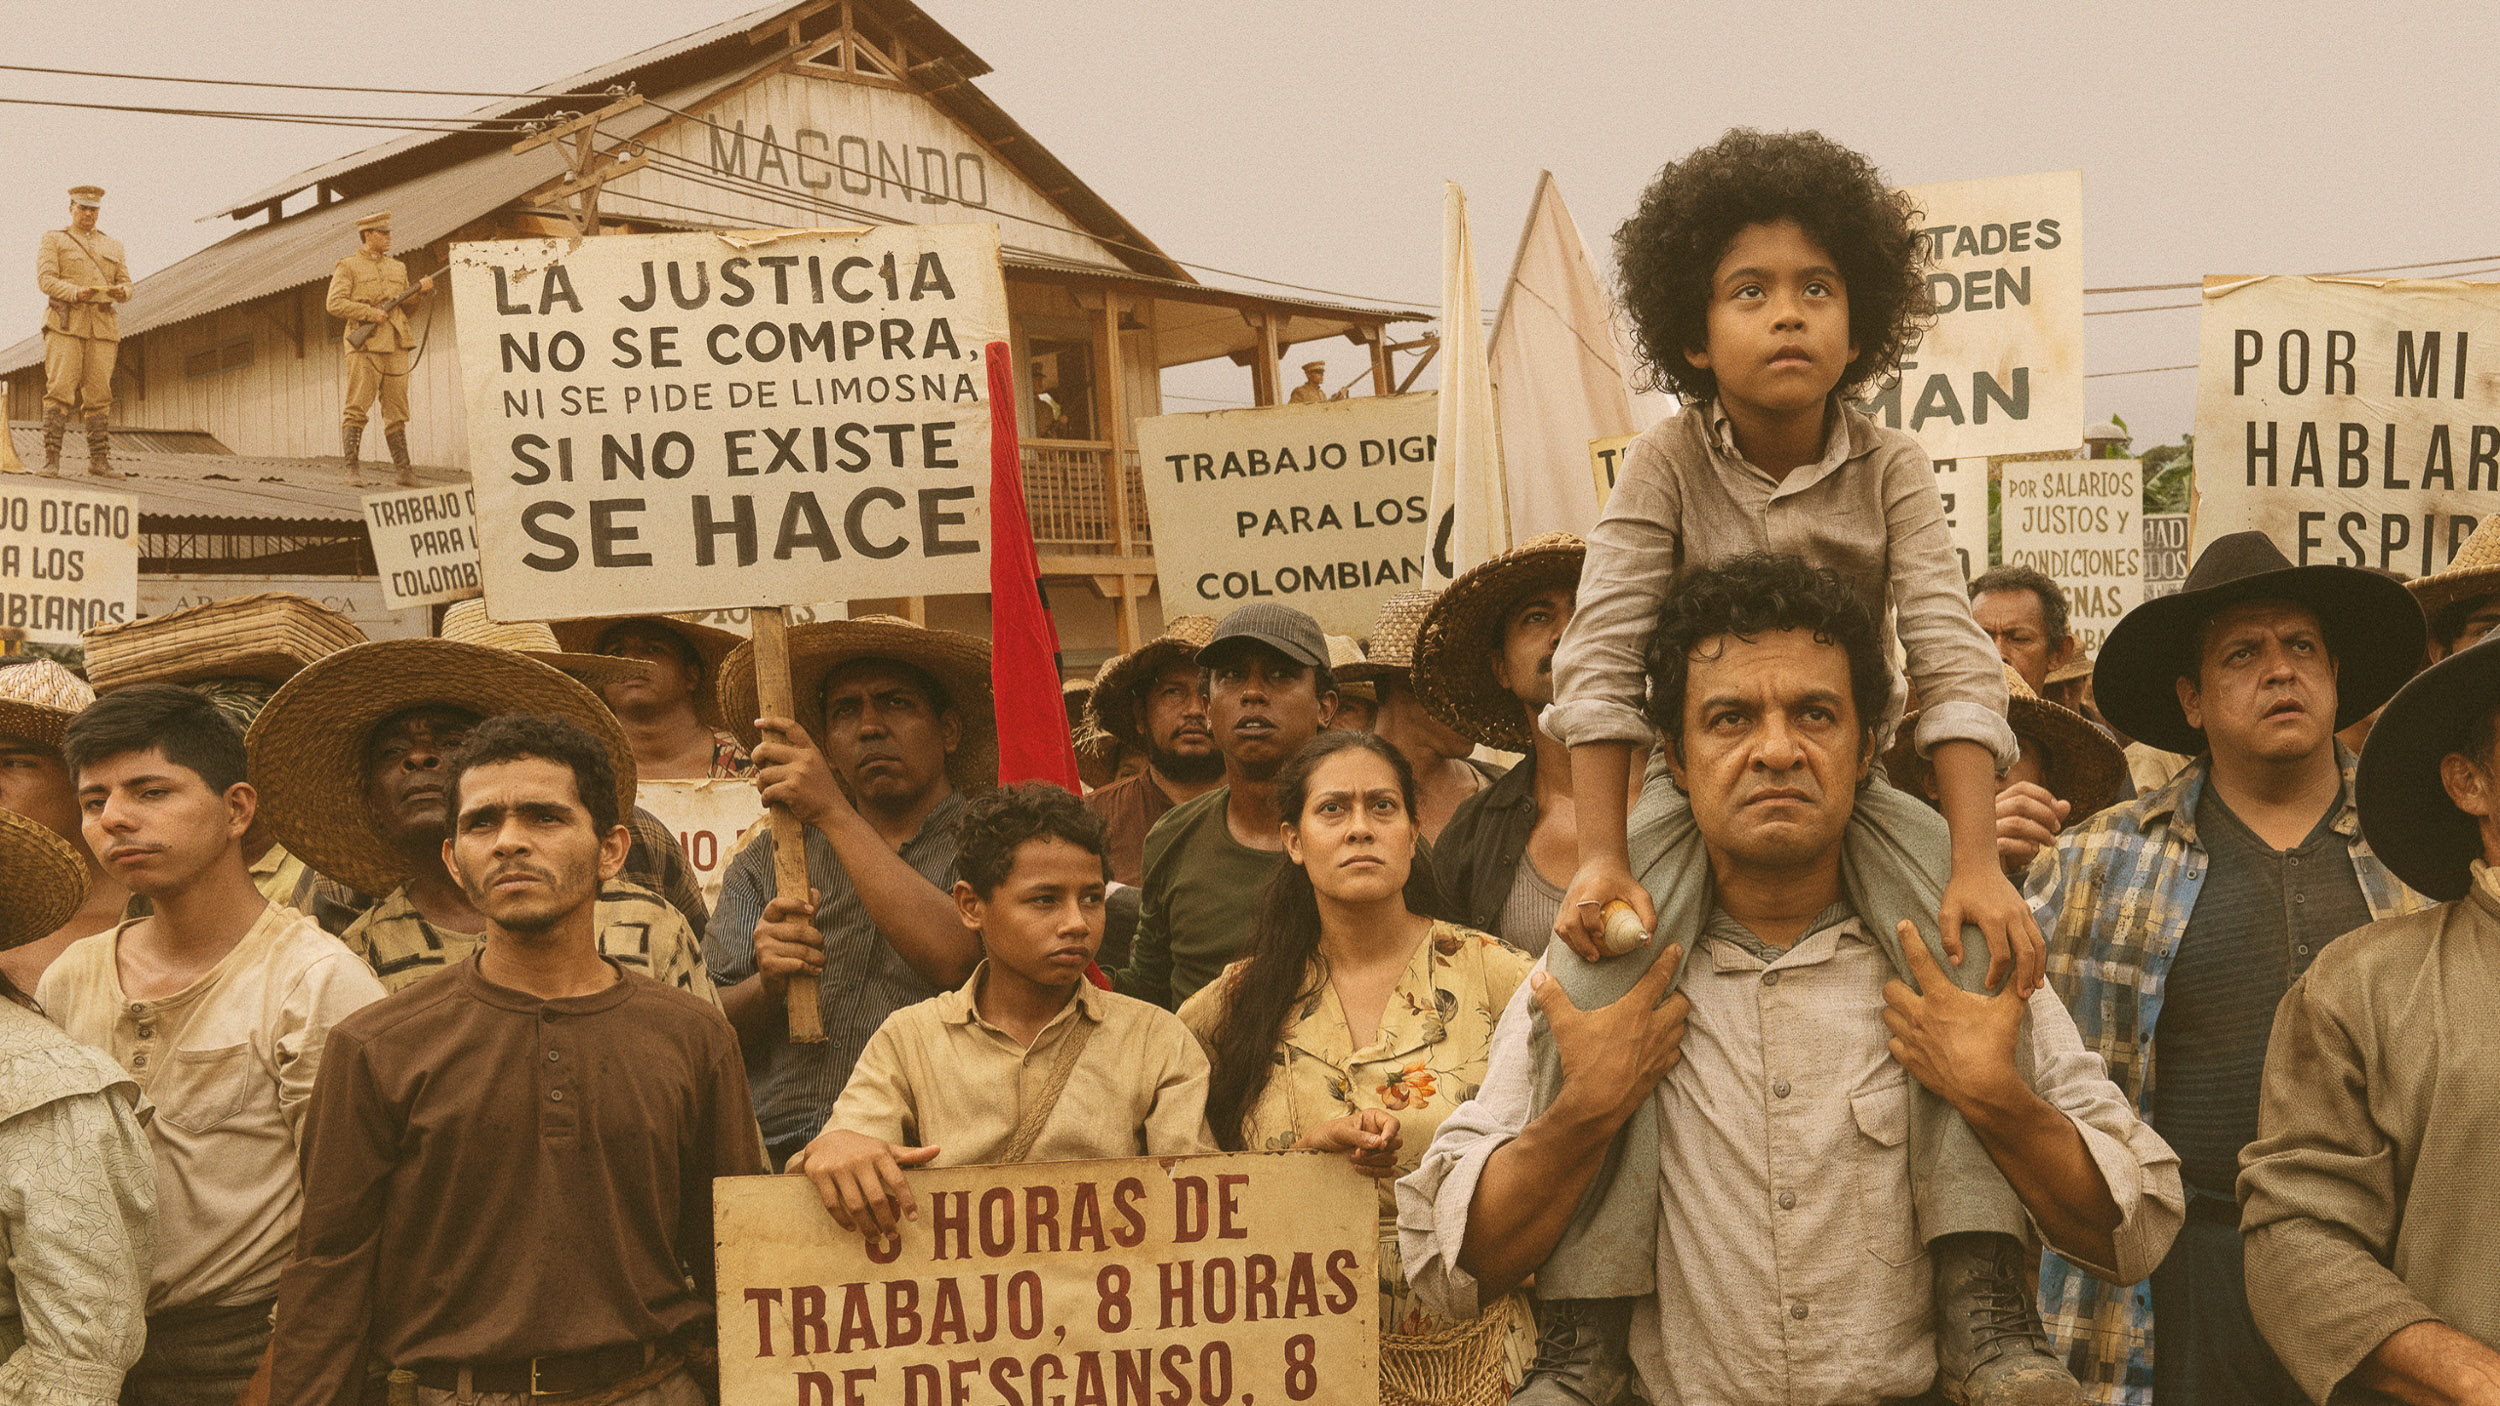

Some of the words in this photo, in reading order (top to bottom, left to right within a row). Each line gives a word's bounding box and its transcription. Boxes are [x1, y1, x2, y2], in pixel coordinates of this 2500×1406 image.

[708, 113, 987, 208] MACONDO
[492, 264, 584, 316] LA
[618, 251, 956, 313] JUSTICIA
[500, 330, 586, 373] NO
[612, 326, 682, 369] SE
[706, 317, 979, 366] COMPRA,
[2233, 329, 2357, 396] POR
[2394, 330, 2469, 400] MI
[503, 388, 545, 419] NI
[559, 385, 608, 416] SE
[625, 382, 713, 414] PIDE
[728, 380, 779, 409] DE
[792, 373, 979, 406] LIMOSNA
[511, 433, 574, 486] SI
[601, 431, 695, 482] NO
[725, 421, 959, 477] EXISTE
[1165, 442, 1348, 483] TRABAJO
[2245, 421, 2500, 492] HABLAR
[2009, 479, 2037, 498] POR
[2042, 471, 2134, 498] SALARIOS
[40, 499, 129, 539] DIGNO
[369, 492, 461, 528] TRABAJO
[520, 498, 654, 573] SE
[691, 485, 982, 568] HACE
[1237, 503, 1343, 538] PARA
[1353, 496, 1428, 529] LOS
[2022, 504, 2109, 534] JUSTOS
[2117, 509, 2129, 534] Y
[32, 546, 85, 582] LOS
[409, 527, 465, 559] PARA
[2012, 548, 2140, 578] CONDICIONES
[0, 592, 126, 631] BIANOS
[929, 1176, 1148, 1262] HORAS
[1171, 1173, 1251, 1244] DE
[743, 1269, 1067, 1359] TRABAJO,
[1096, 1263, 1133, 1334] 8
[1155, 1249, 1361, 1330] HORAS
[1283, 1333, 1318, 1402] 8
